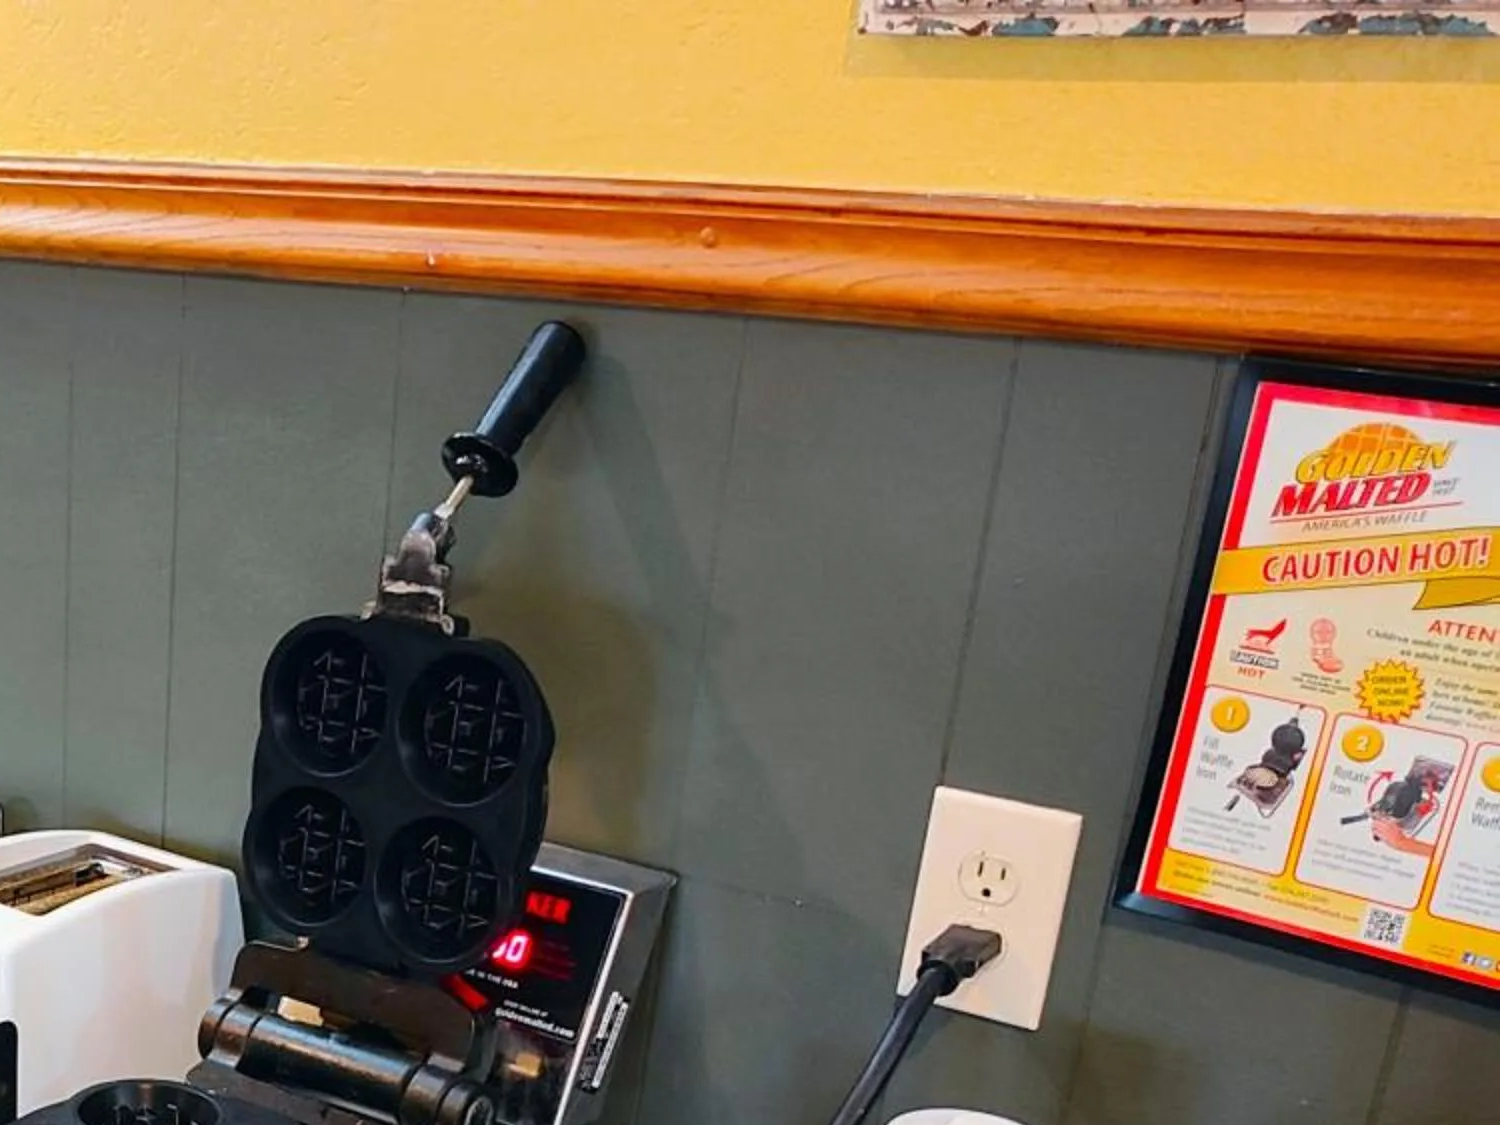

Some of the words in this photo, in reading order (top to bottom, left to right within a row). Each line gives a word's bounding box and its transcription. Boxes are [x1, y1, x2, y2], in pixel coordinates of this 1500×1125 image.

[1295, 441, 1457, 484] GOLDEN
[1271, 472, 1432, 518] MALTED
[1301, 517, 1371, 533] AMERICA'S
[1375, 511, 1429, 526] WAFFLE
[1262, 546, 1400, 583] CAUTION
[1408, 537, 1490, 572] HOT!
[1427, 619, 1500, 643] ATTEN
[1356, 735, 1370, 752] 2
[1332, 764, 1371, 783] Rotate
